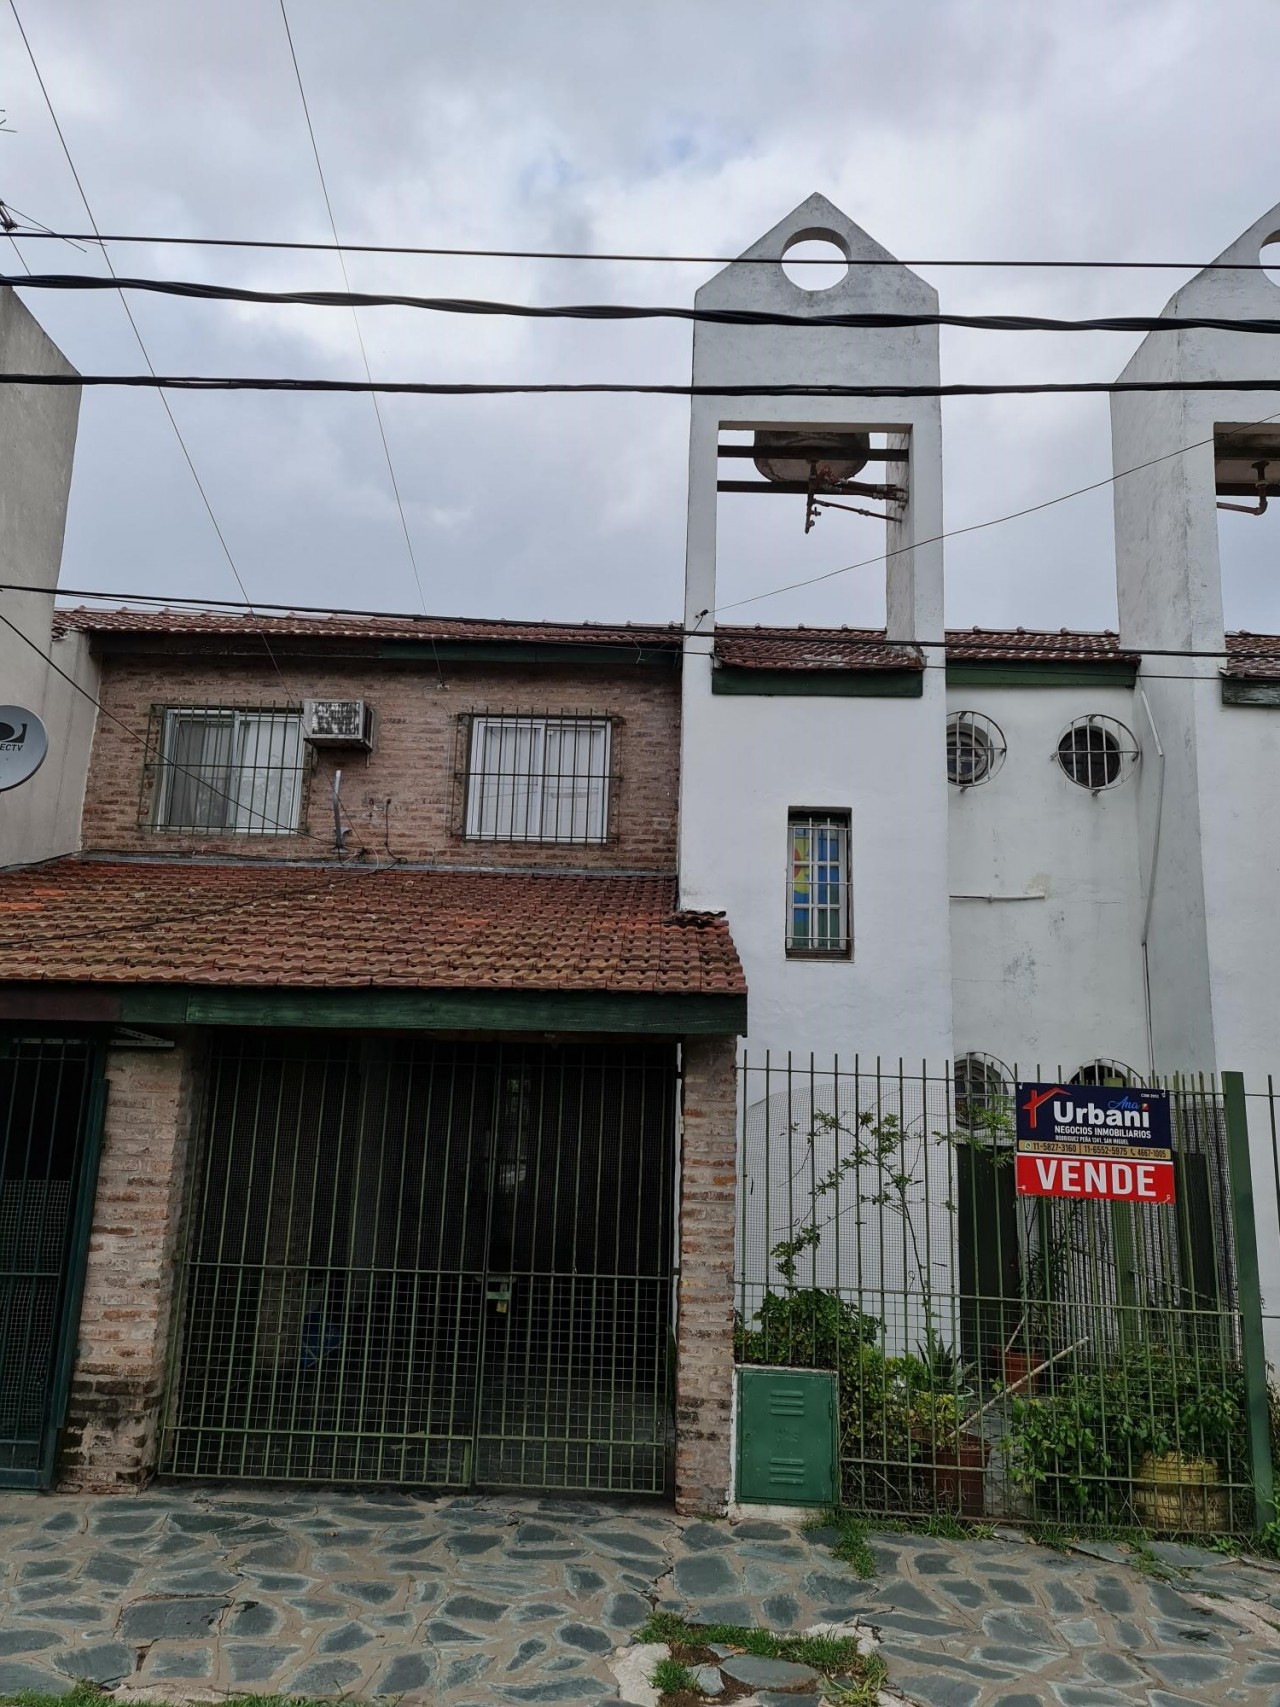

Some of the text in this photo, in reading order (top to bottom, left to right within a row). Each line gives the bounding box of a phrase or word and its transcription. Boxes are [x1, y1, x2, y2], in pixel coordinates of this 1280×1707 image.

[1108, 1096, 1140, 1110] Ana
[1053, 1100, 1150, 1128] Urbani
[1054, 1125, 1152, 1139] NEGOCIOS INMOBILIARIOS
[1035, 1158, 1157, 1197] VENDE
